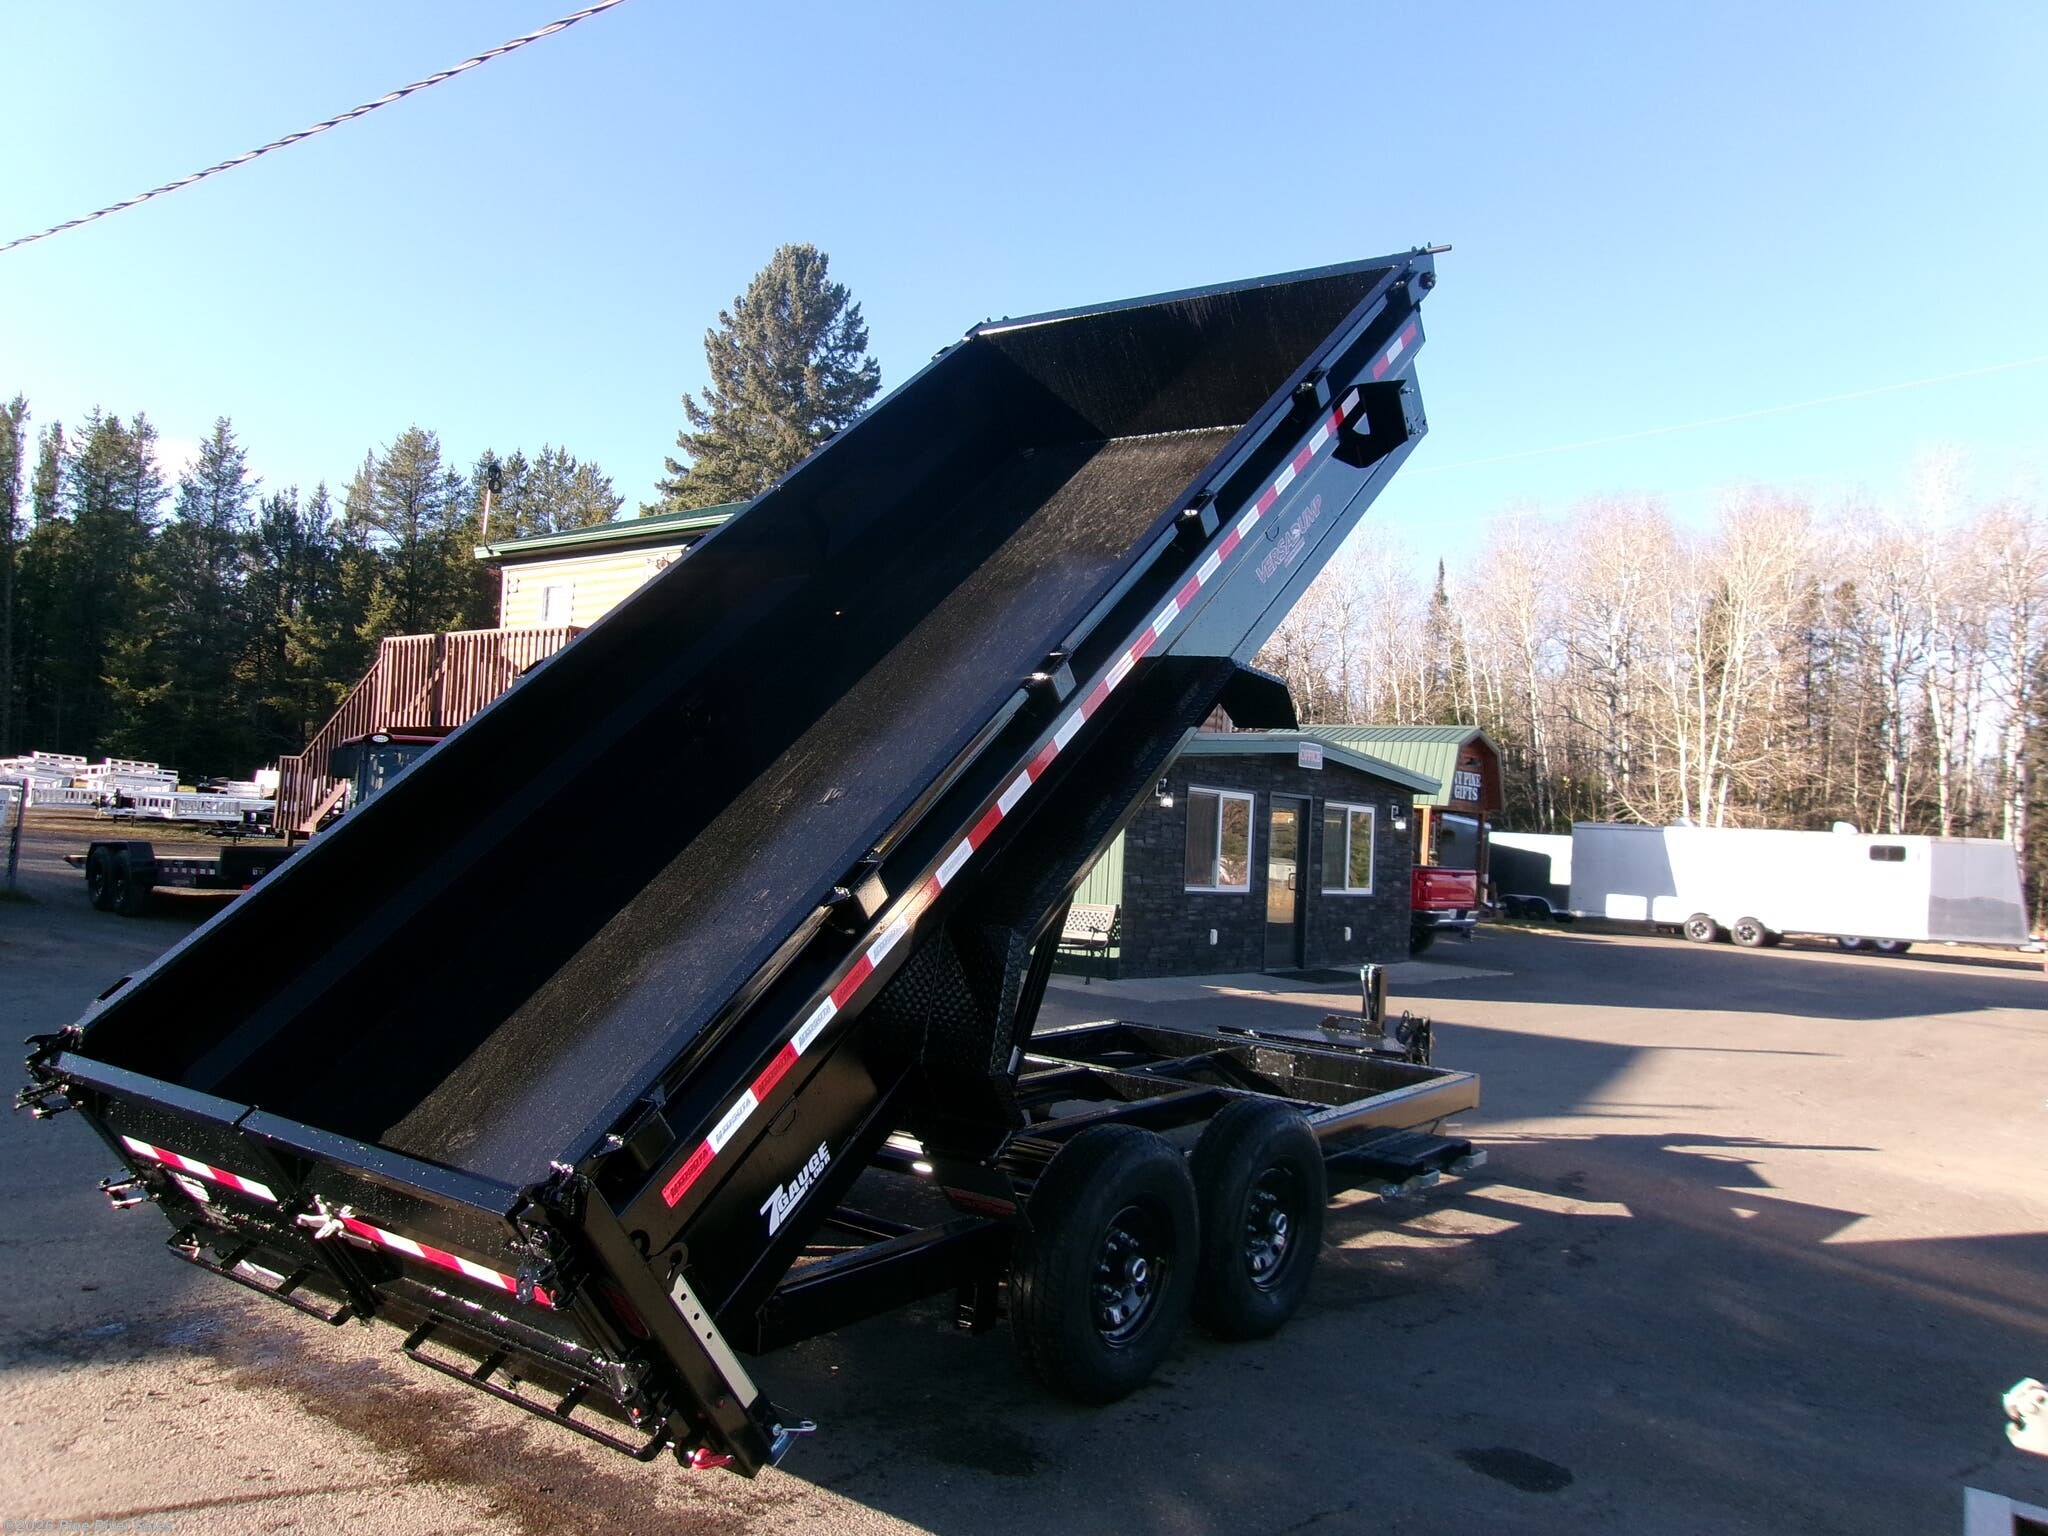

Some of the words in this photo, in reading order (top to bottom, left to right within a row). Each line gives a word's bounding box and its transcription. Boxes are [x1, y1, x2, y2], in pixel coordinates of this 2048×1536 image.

[1256, 494, 1322, 584] VERSADUMP
[1464, 772, 1481, 787] PINE
[1454, 786, 1478, 801] GIFTS
[804, 1154, 831, 1190] FLOOR
